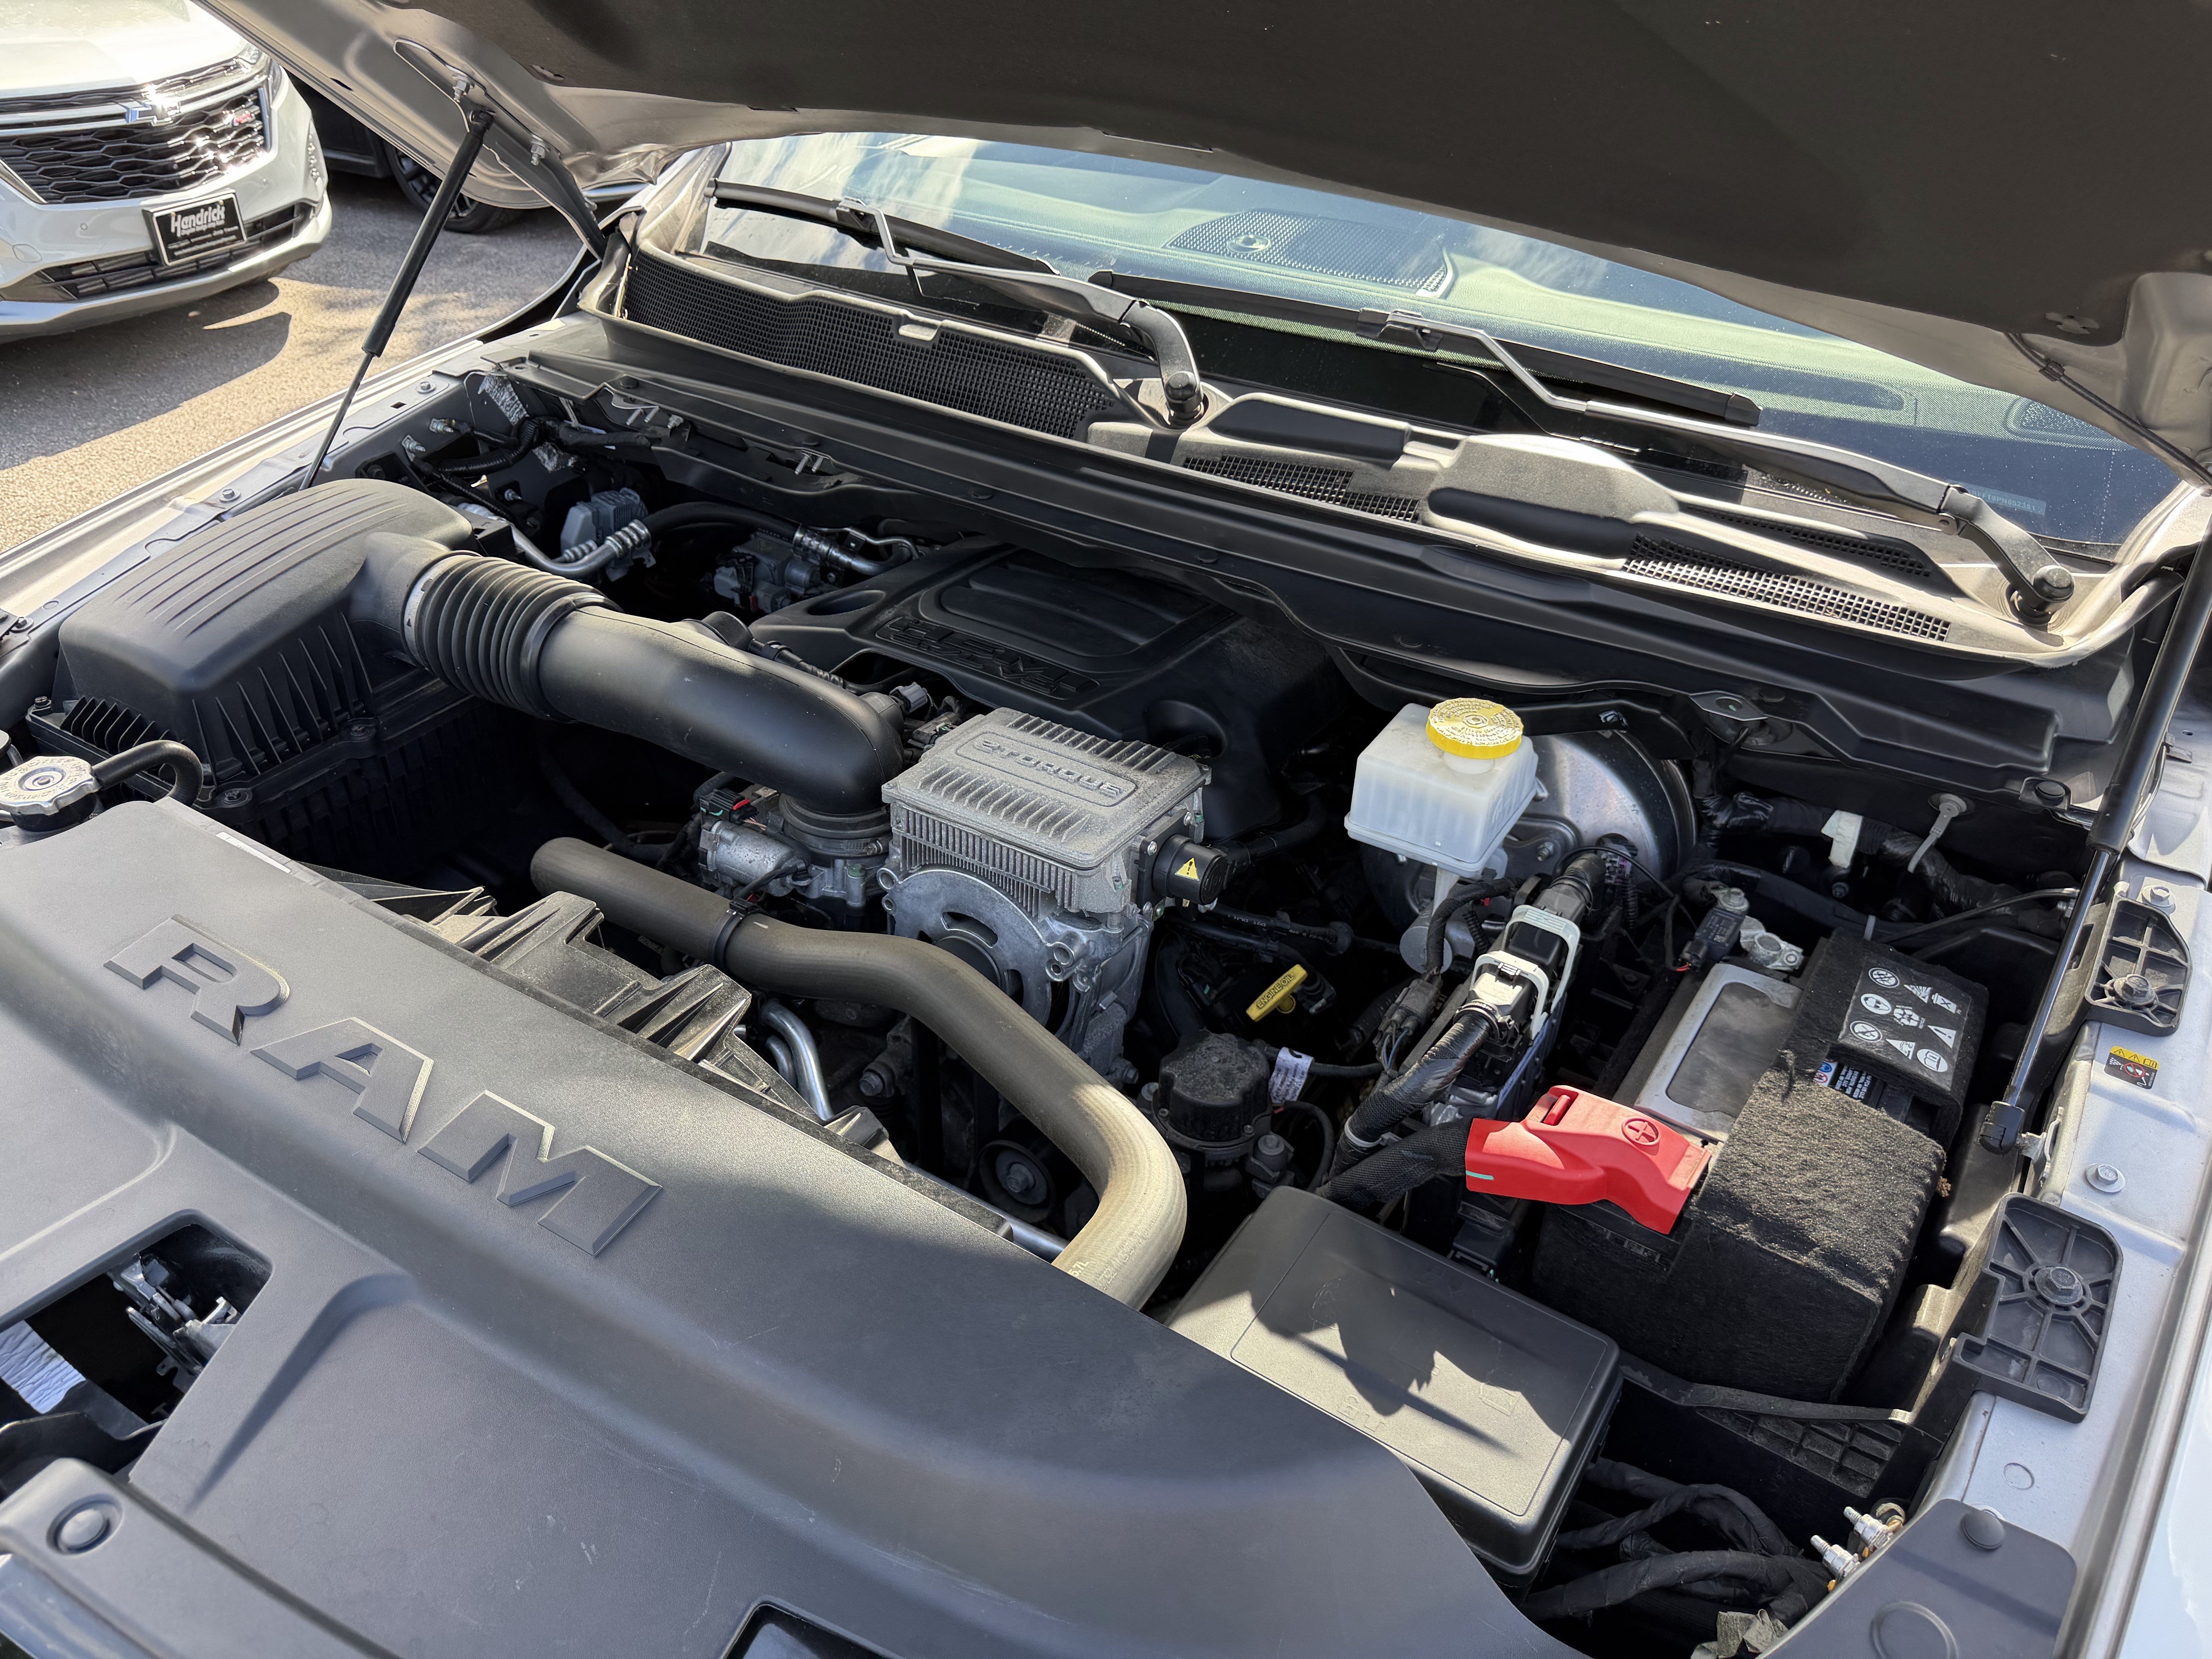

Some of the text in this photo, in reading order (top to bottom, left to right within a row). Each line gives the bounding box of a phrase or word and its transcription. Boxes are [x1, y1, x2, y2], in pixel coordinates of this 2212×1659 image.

[170, 204, 225, 237] Hendrick
[1256, 973, 1295, 1009] ENGINE OIL
[103, 914, 663, 1257] RAM
